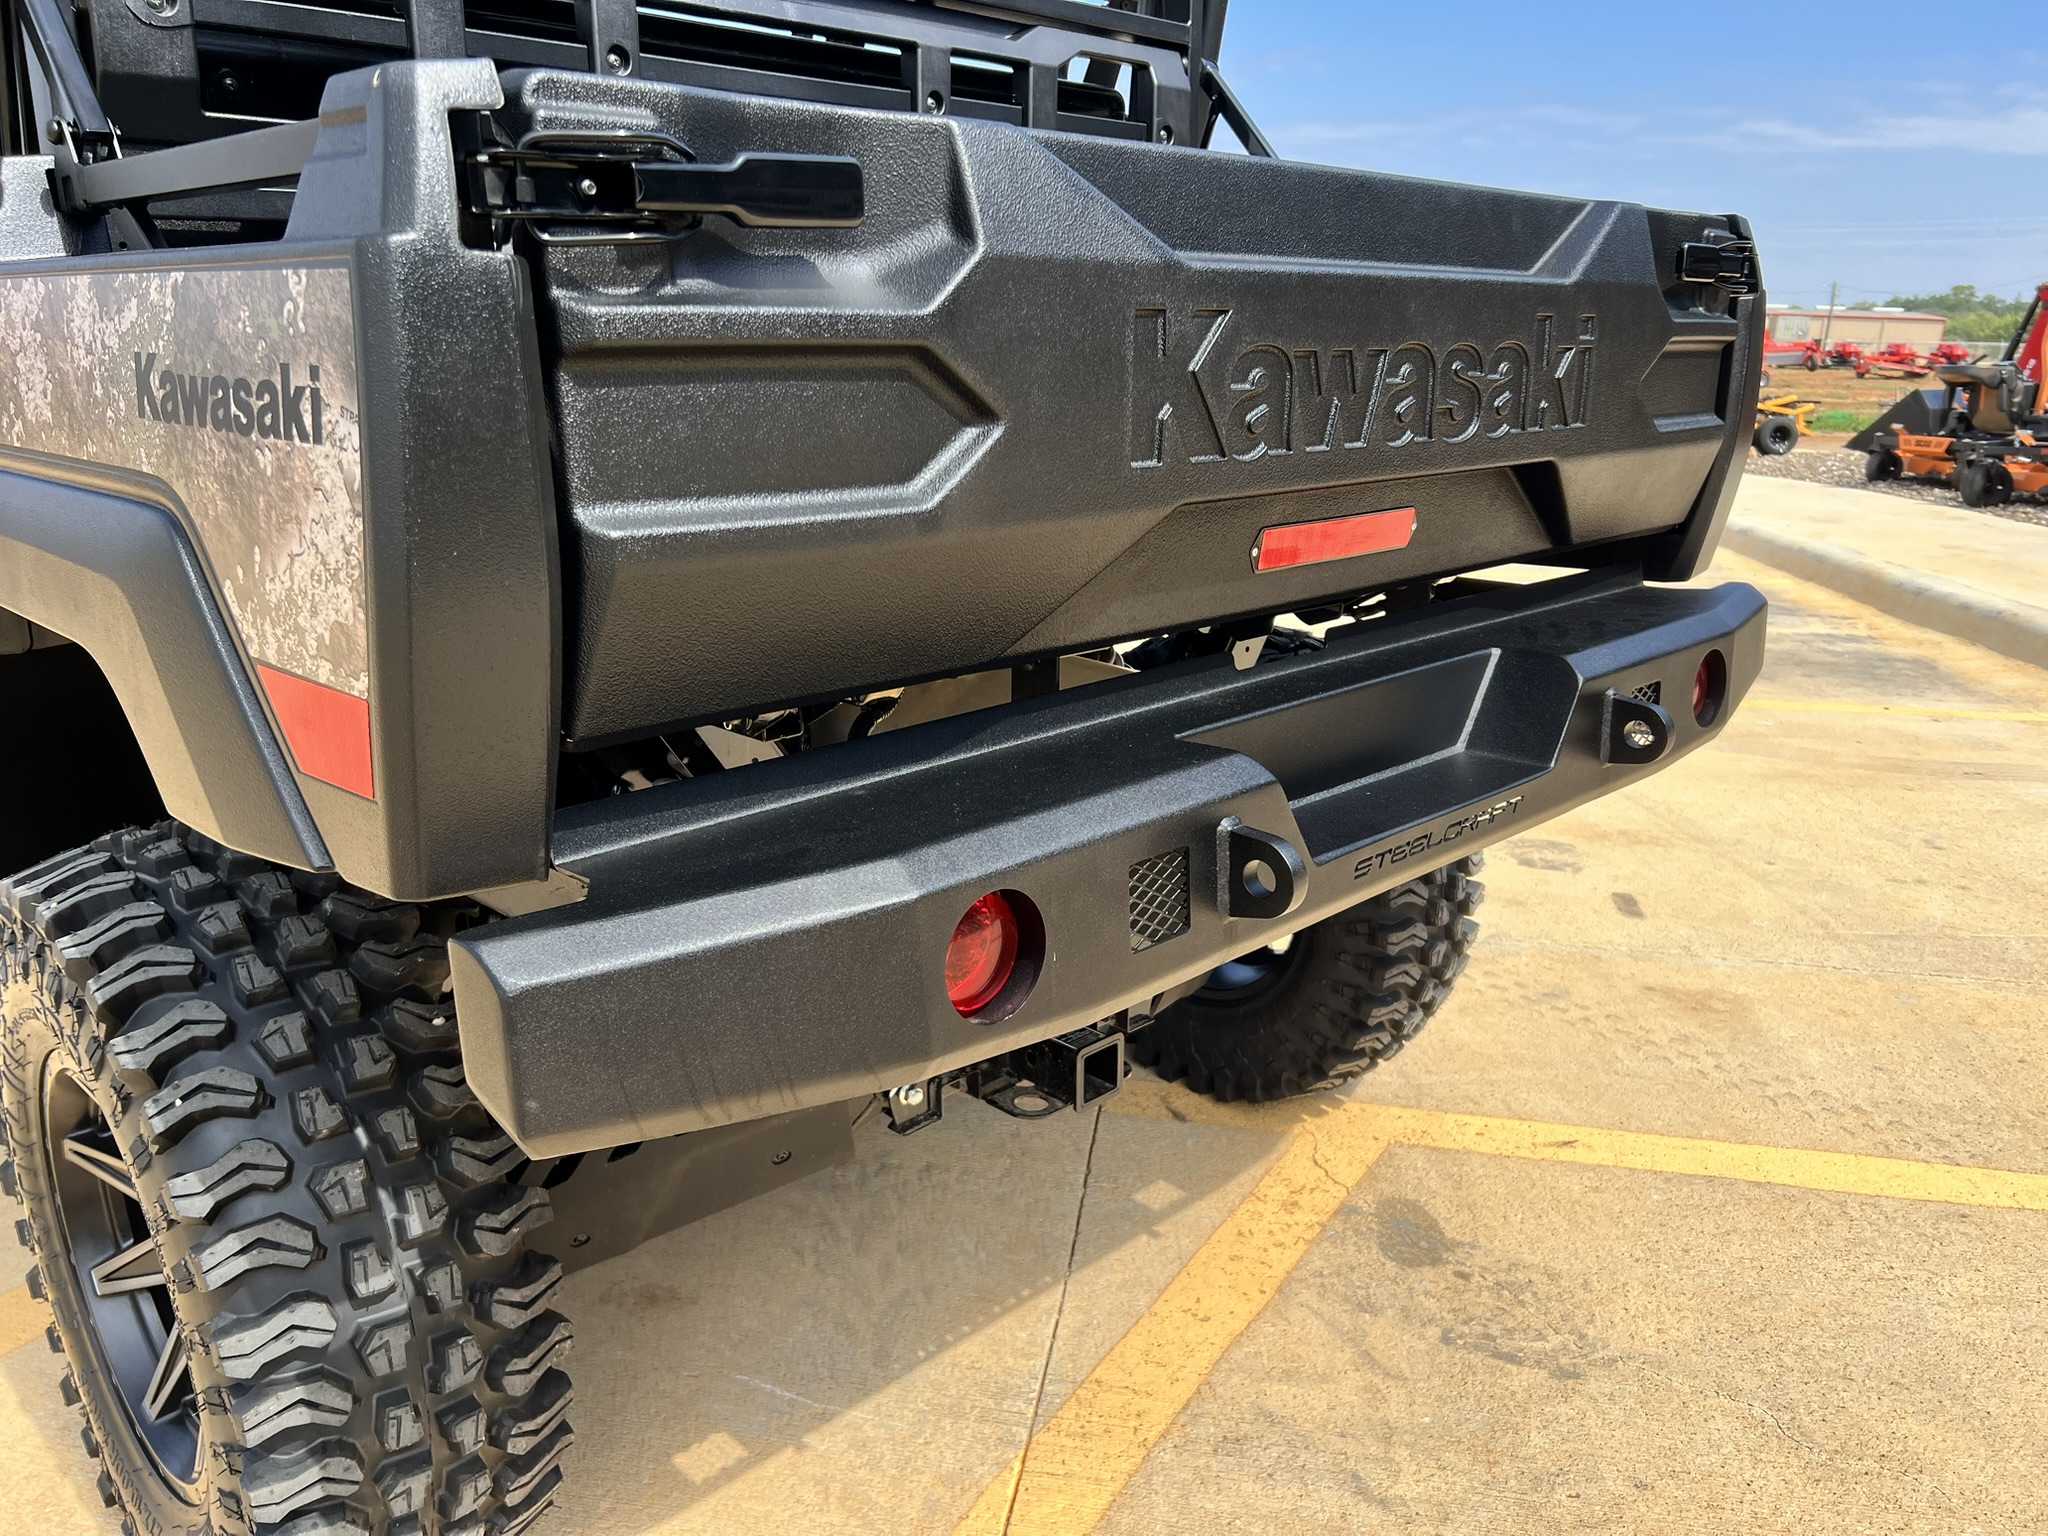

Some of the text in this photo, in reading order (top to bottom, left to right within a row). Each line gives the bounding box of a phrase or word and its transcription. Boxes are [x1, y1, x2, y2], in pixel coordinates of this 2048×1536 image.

[134, 351, 322, 444] Kawasaki
[1130, 306, 1595, 469] Kawasaki
[1353, 795, 1525, 880] STEELCRAFT
